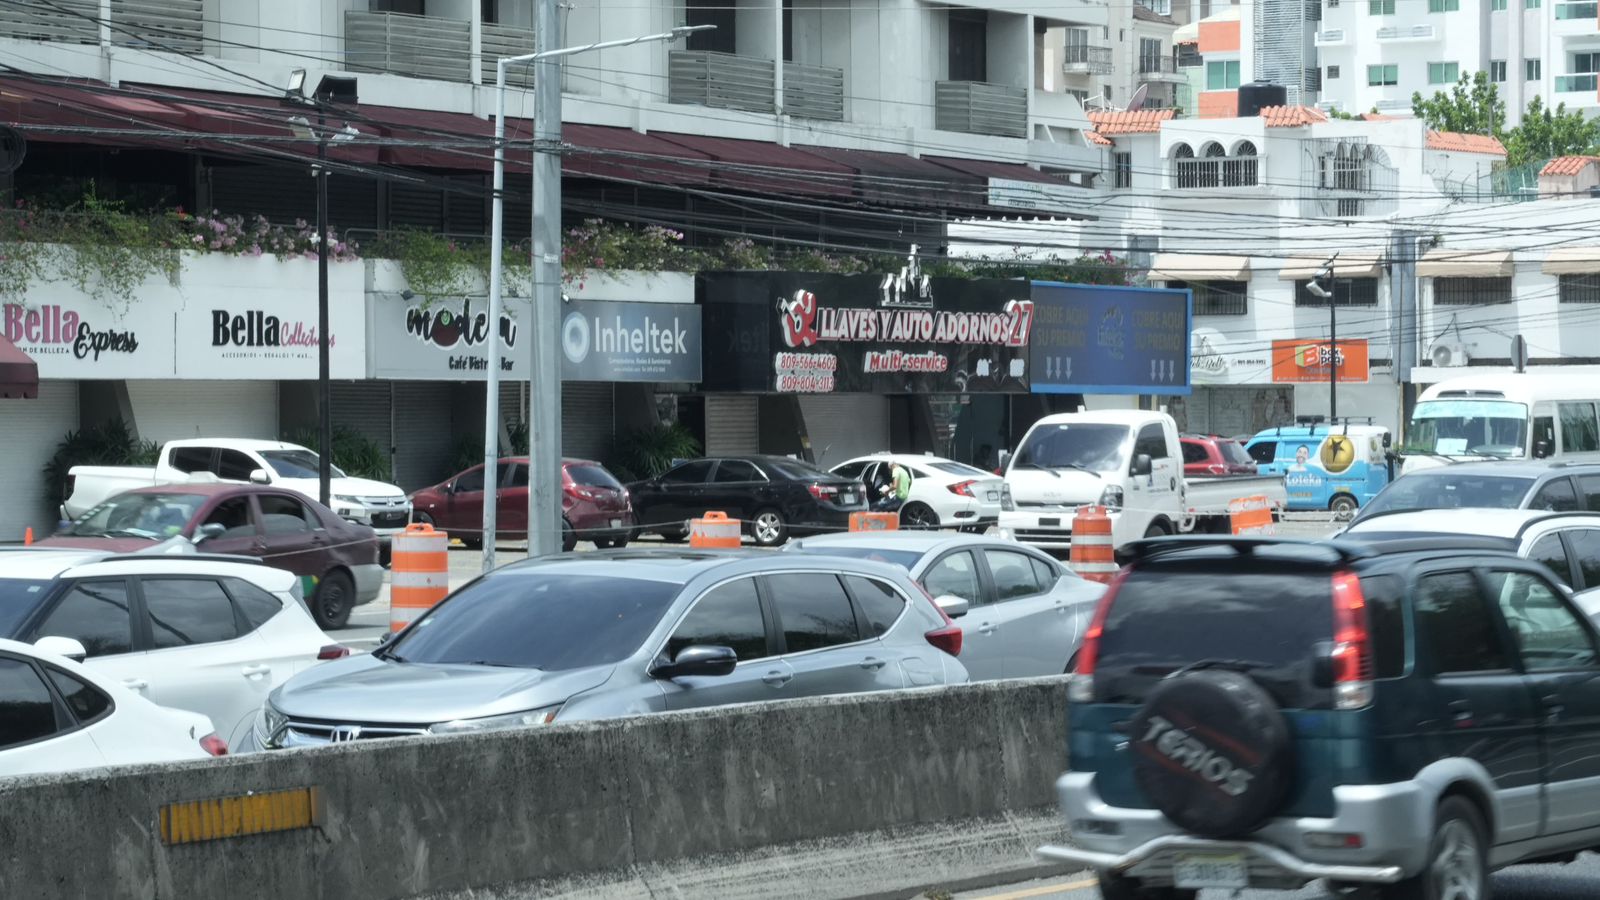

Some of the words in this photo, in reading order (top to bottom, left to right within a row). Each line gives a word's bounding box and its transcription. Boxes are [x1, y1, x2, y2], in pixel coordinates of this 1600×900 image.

[4, 304, 79, 343] Bella
[73, 322, 139, 361] Express
[212, 310, 280, 346] Bella
[595, 315, 688, 354] Inheltek
[821, 310, 876, 339] LLAVES
[880, 311, 891, 339] Y
[891, 311, 933, 340] AUTO
[935, 312, 1010, 342] ADORNOS
[1006, 301, 1034, 345] 27
[449, 355, 467, 370] Café
[469, 356, 489, 370] Bistr
[501, 356, 514, 371] Bar
[780, 354, 837, 370] 809-566-4602
[870, 352, 948, 370] Multi-service
[781, 375, 834, 390] 809-804-3113
[1141, 715, 1255, 796] TERIOS
